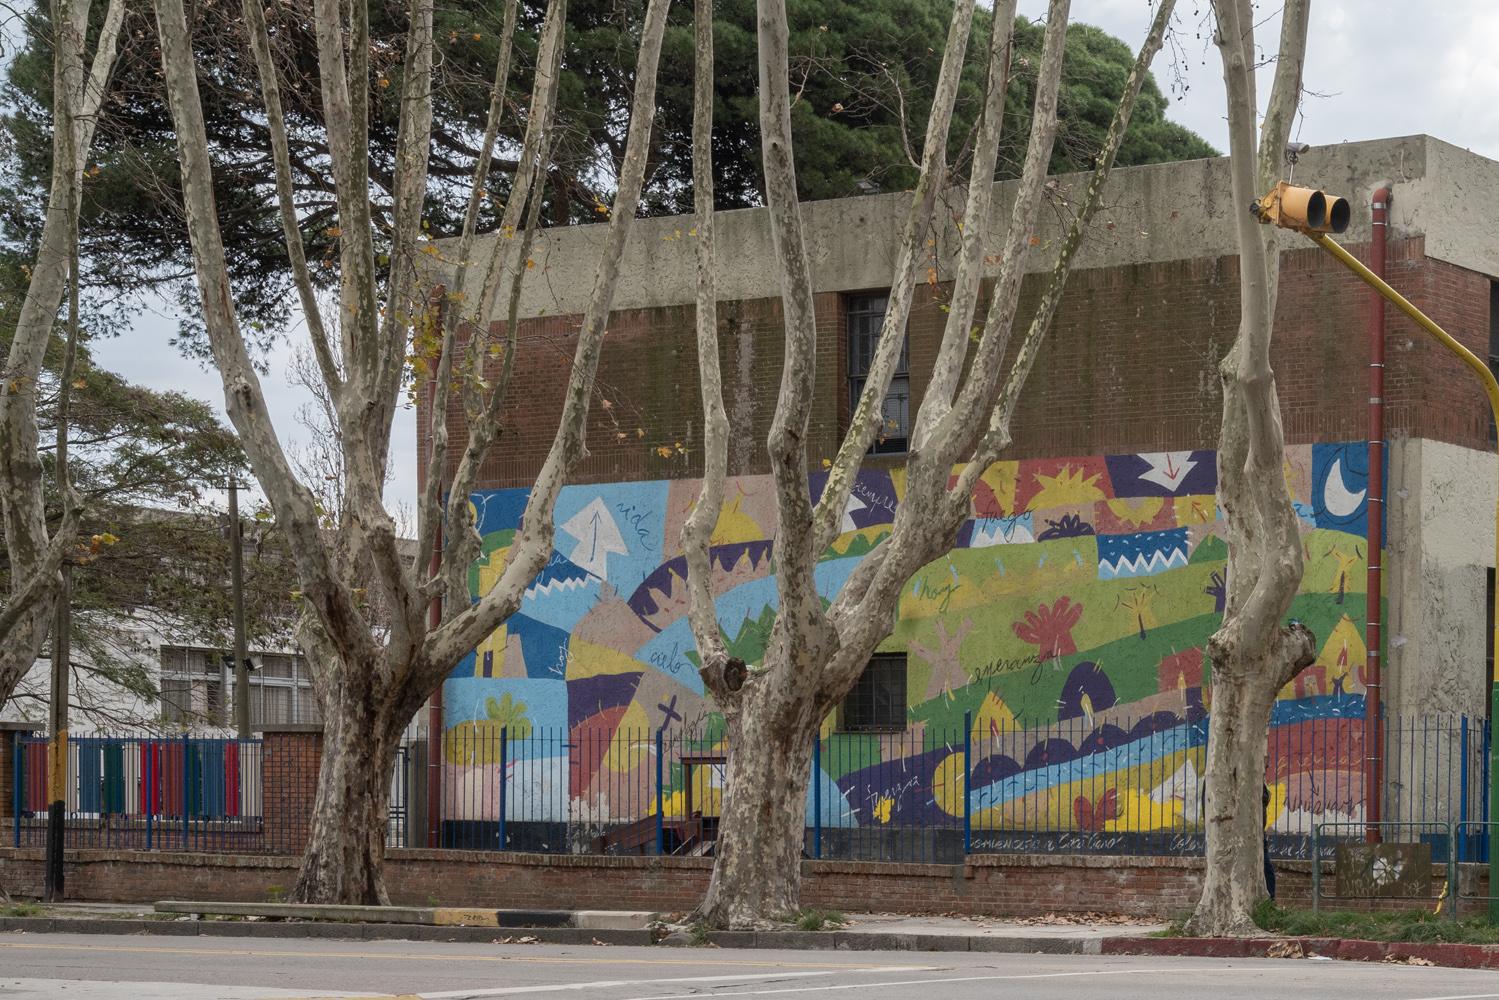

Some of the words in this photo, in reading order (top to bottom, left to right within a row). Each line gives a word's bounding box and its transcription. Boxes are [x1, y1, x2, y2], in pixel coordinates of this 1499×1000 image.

[981, 500, 1037, 542] fuego
[919, 576, 962, 615] hoy
[548, 637, 574, 675] hoy
[650, 642, 695, 674] cielo
[973, 650, 1058, 694] esperanza
